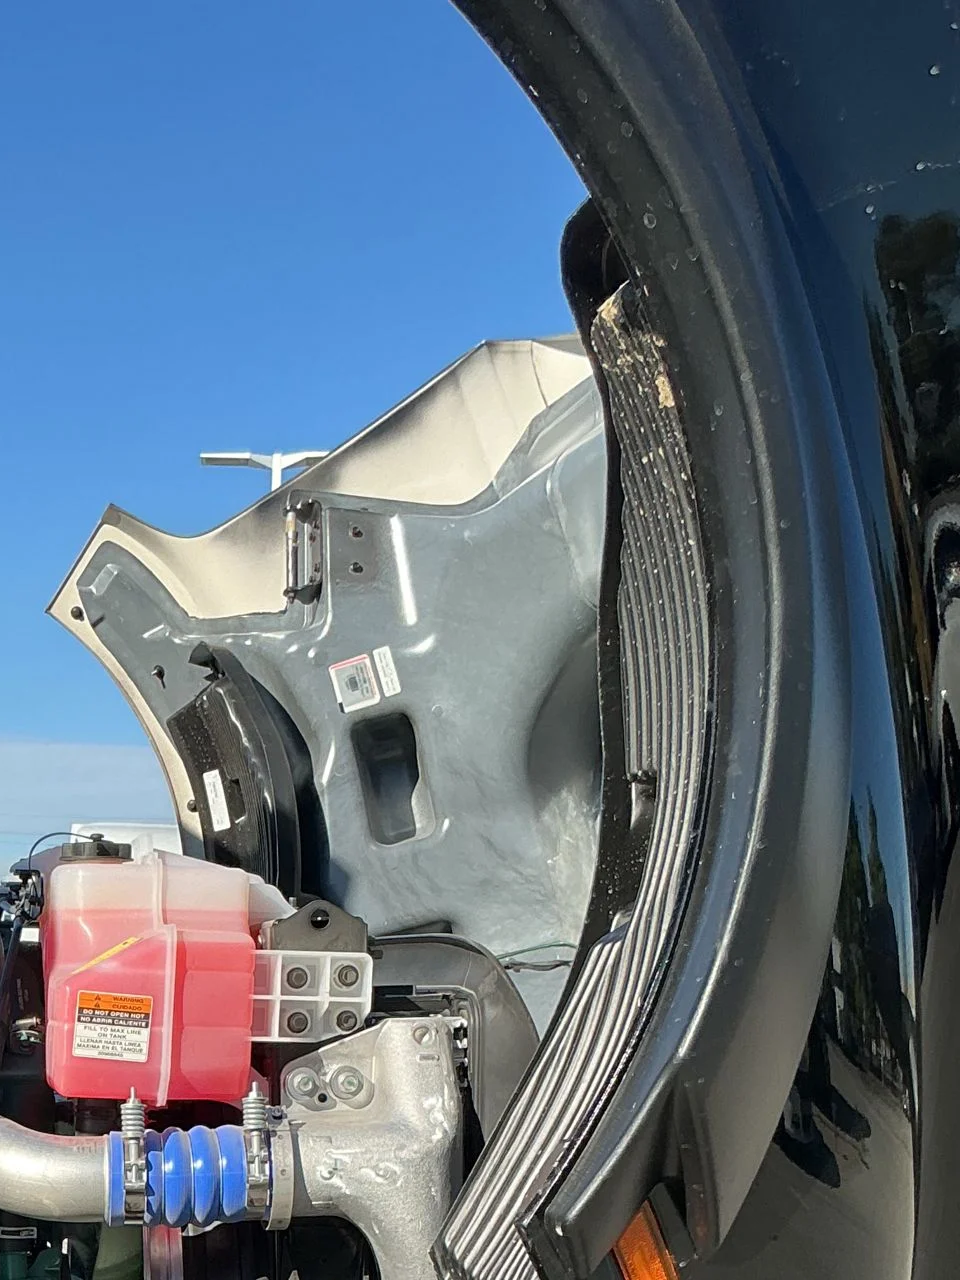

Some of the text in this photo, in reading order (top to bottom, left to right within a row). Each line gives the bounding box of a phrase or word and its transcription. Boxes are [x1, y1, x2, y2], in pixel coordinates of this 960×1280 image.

[112, 996, 144, 1004] WARNING
[114, 1019, 147, 1027] CALIENTE
[120, 1046, 144, 1054] TANQUE
